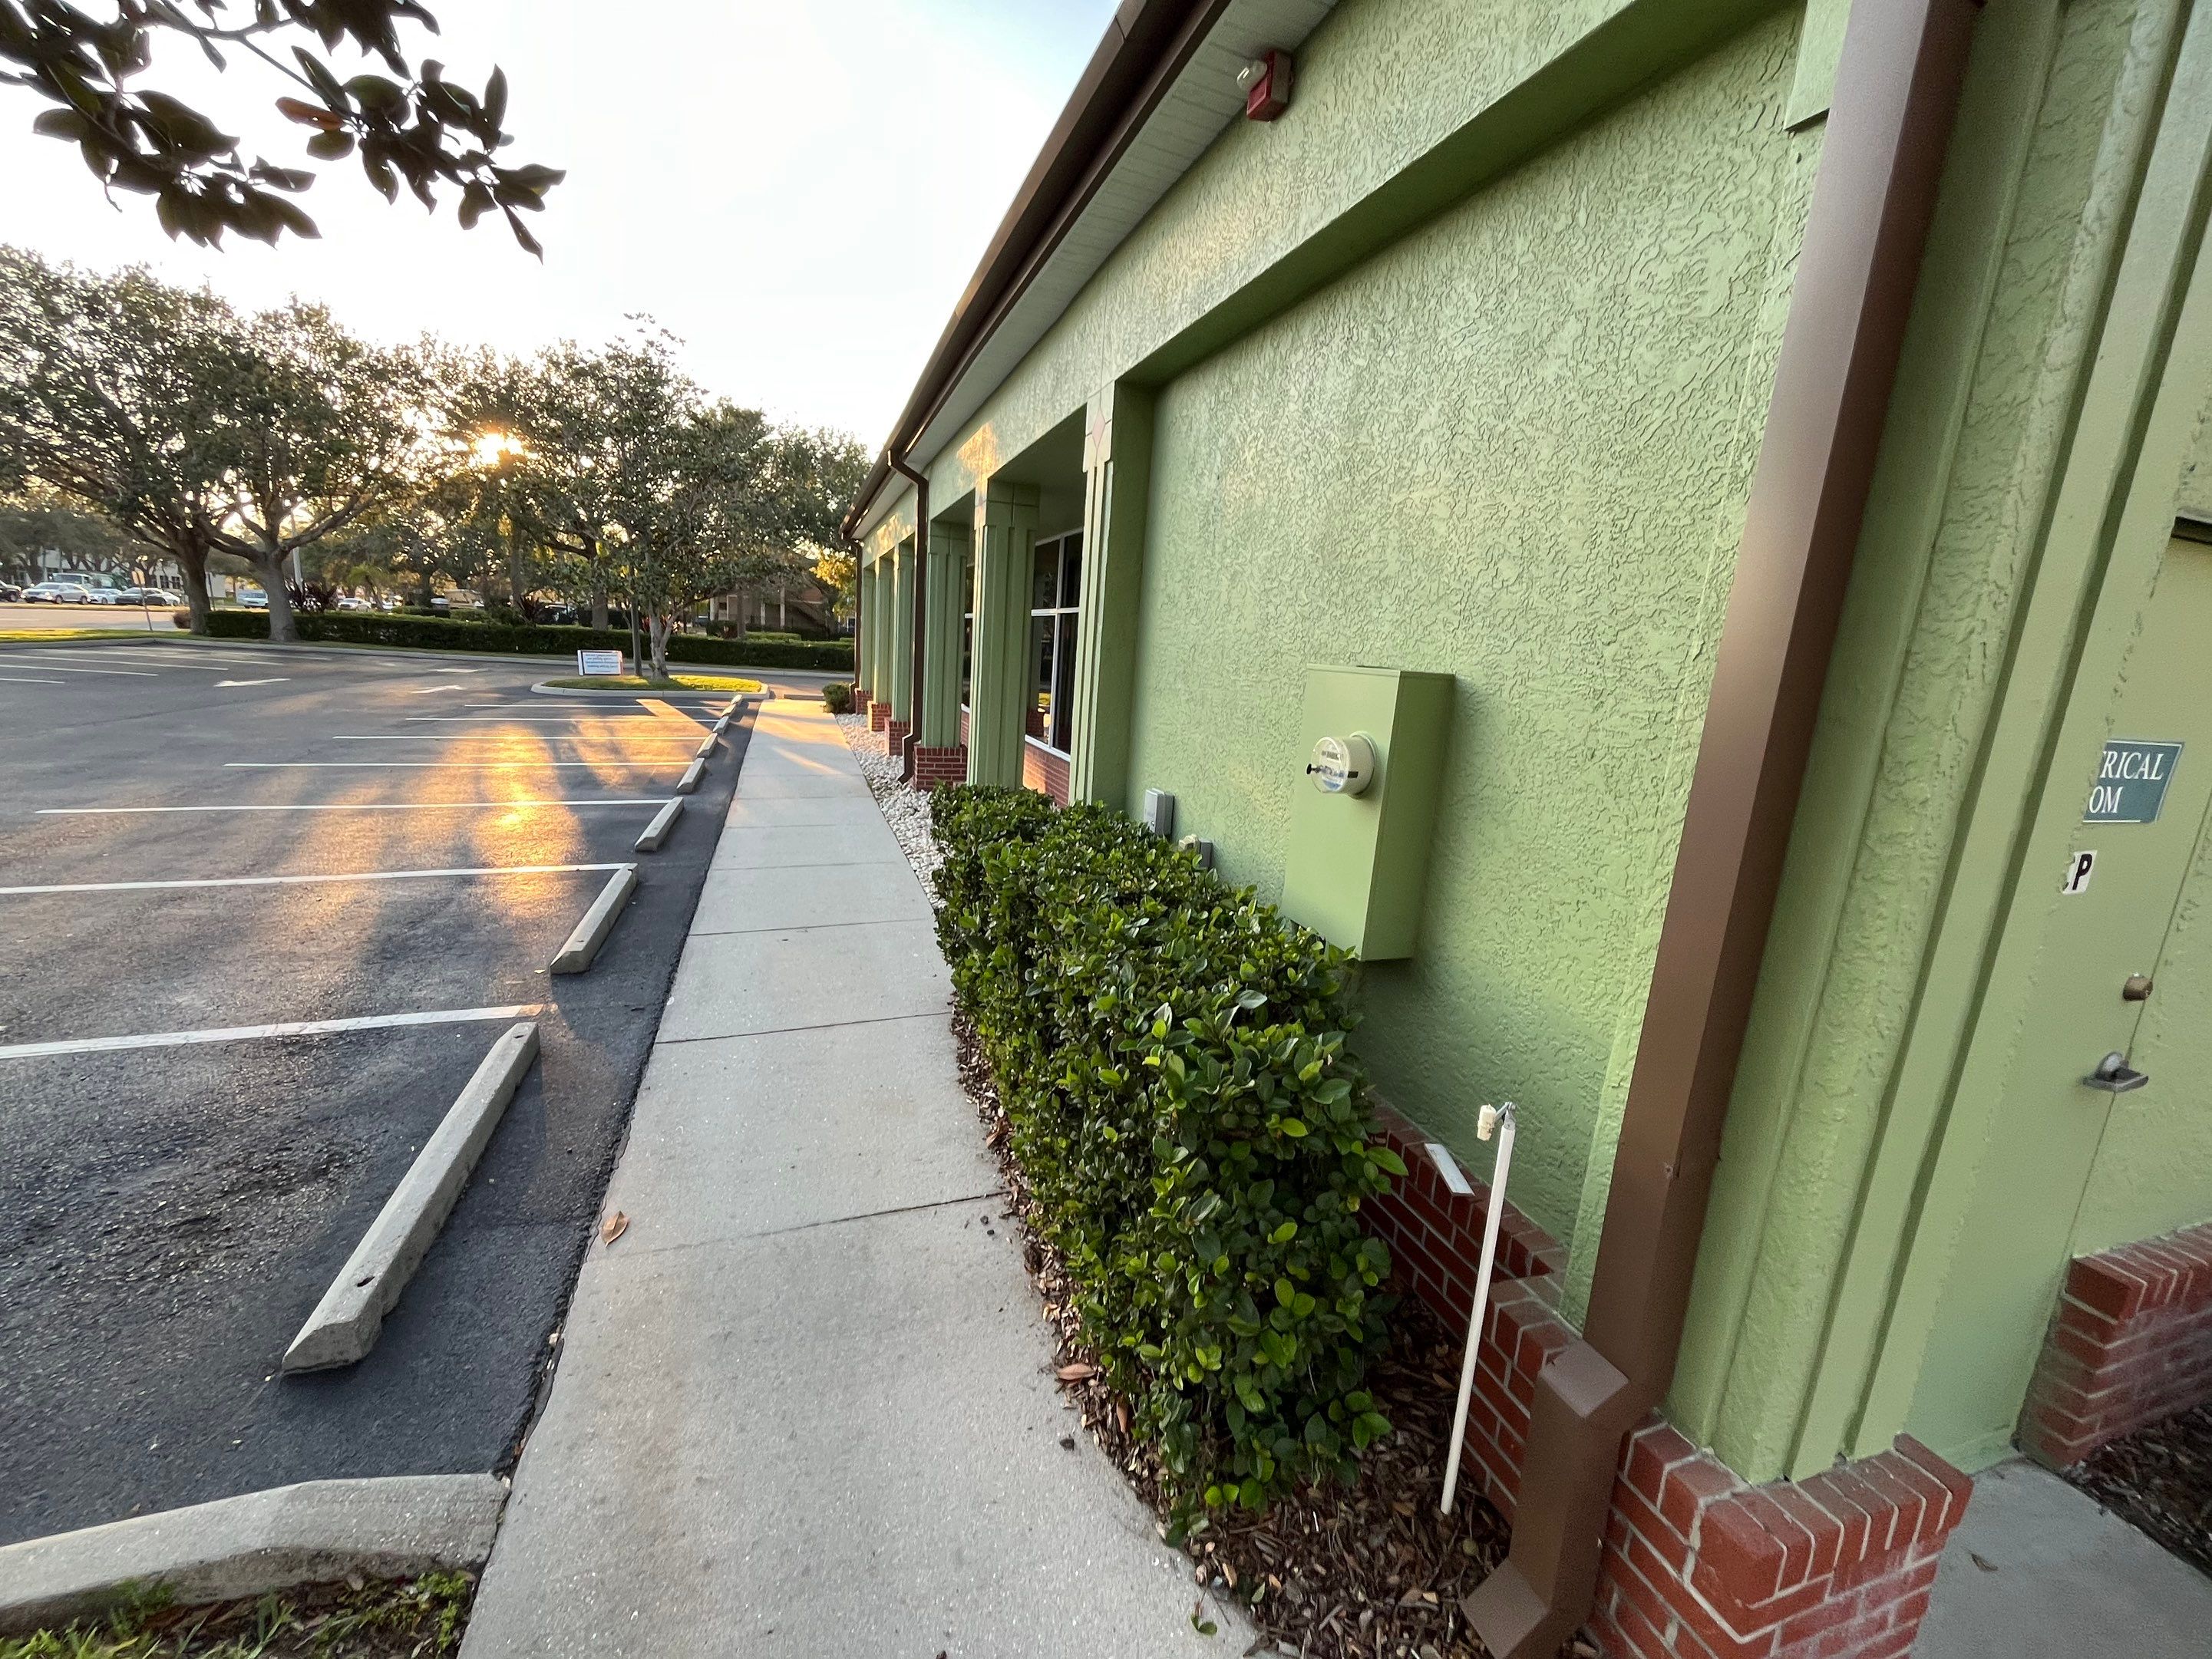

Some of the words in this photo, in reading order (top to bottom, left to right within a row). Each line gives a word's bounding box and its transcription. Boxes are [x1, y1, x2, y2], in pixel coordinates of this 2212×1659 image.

[2100, 751, 2164, 780] RICAL
[2088, 786, 2124, 813] OM
[2063, 853, 2092, 891] P
